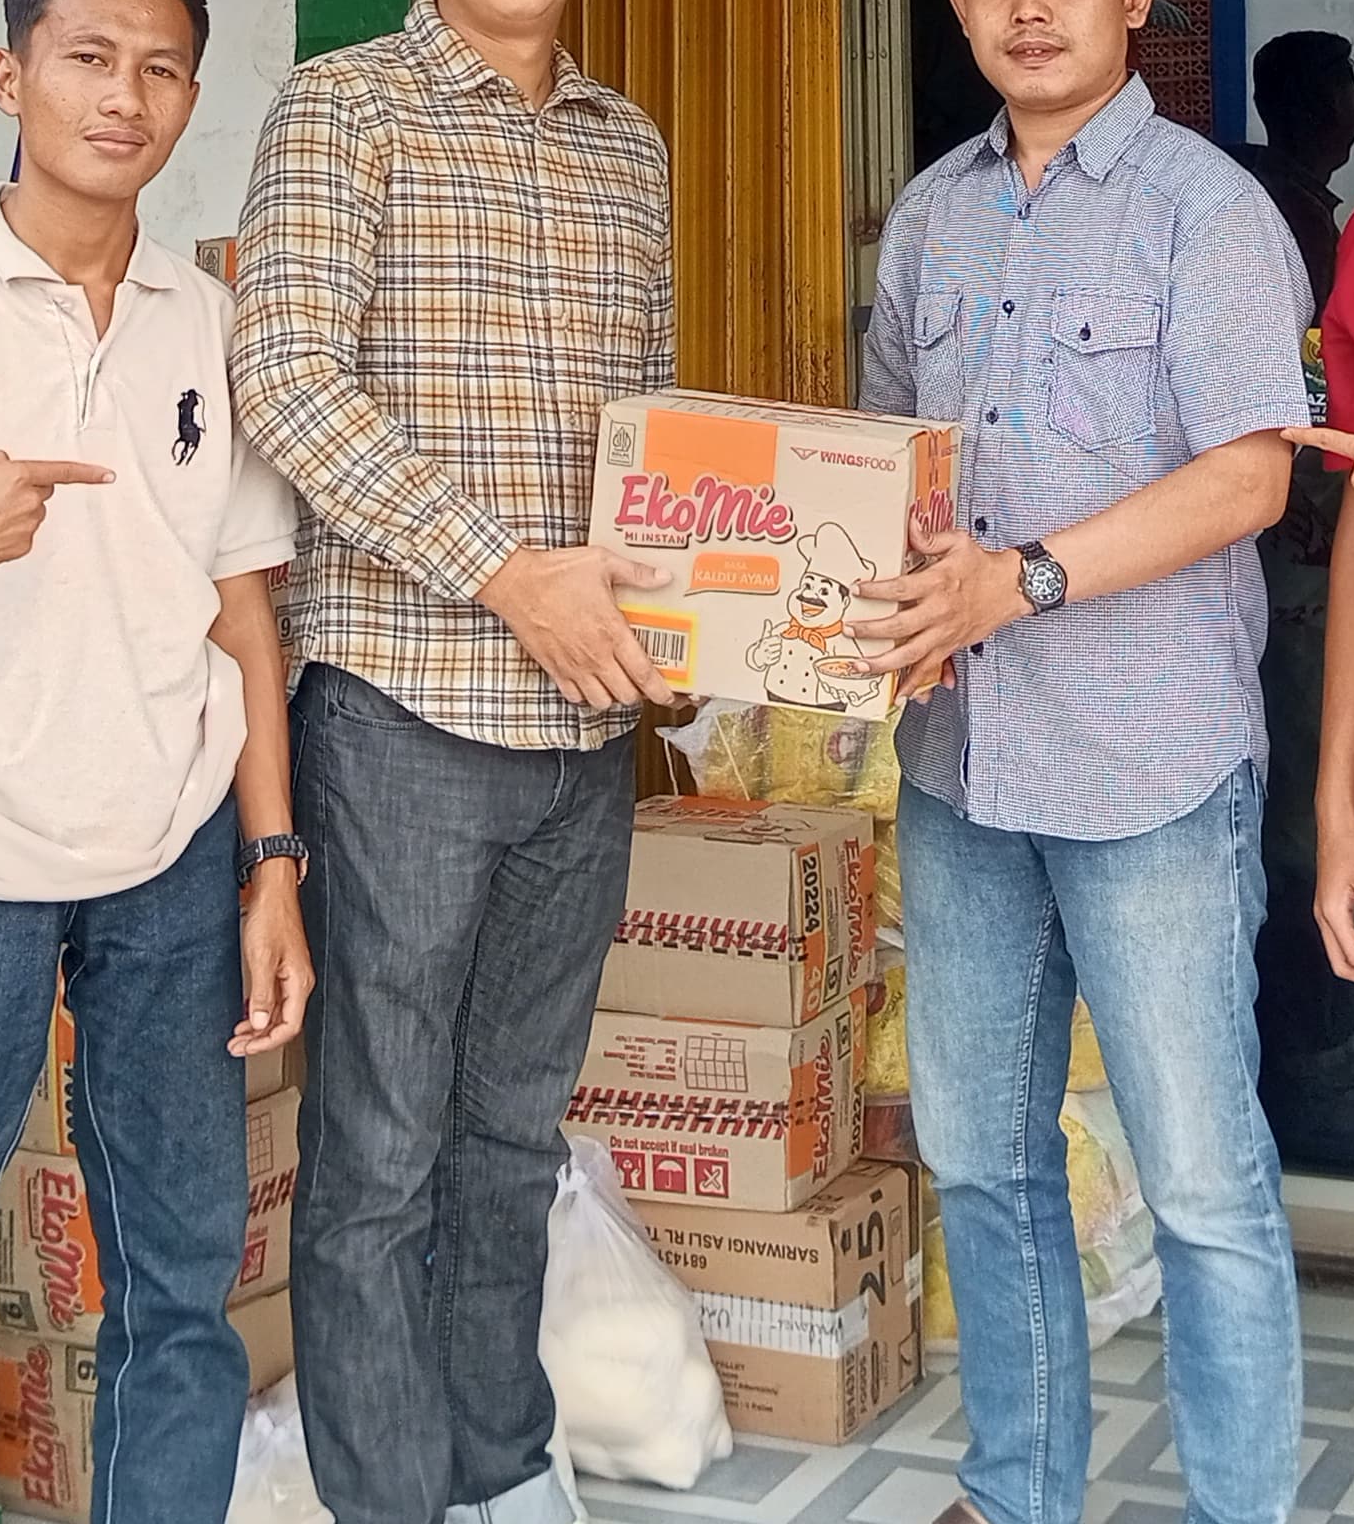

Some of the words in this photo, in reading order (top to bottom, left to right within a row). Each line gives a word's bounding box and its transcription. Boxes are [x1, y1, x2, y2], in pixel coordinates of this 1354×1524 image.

[820, 450, 897, 472] WINGSFOOD
[614, 475, 792, 538] EkoMie
[625, 531, 638, 541] MI
[641, 533, 686, 544] INSTAN
[694, 569, 737, 582] KALDU
[740, 573, 775, 586] AYAM
[801, 856, 820, 933] 20224
[805, 966, 822, 1012] 40
[610, 1135, 622, 1147] Do
[624, 1138, 638, 1149] not
[640, 1140, 670, 1153] accept
[665, 1229, 685, 1245] RL
[688, 1232, 723, 1249] ASLI
[42, 1167, 83, 1331] EkoMie
[728, 1238, 819, 1264] SARIWANGI
